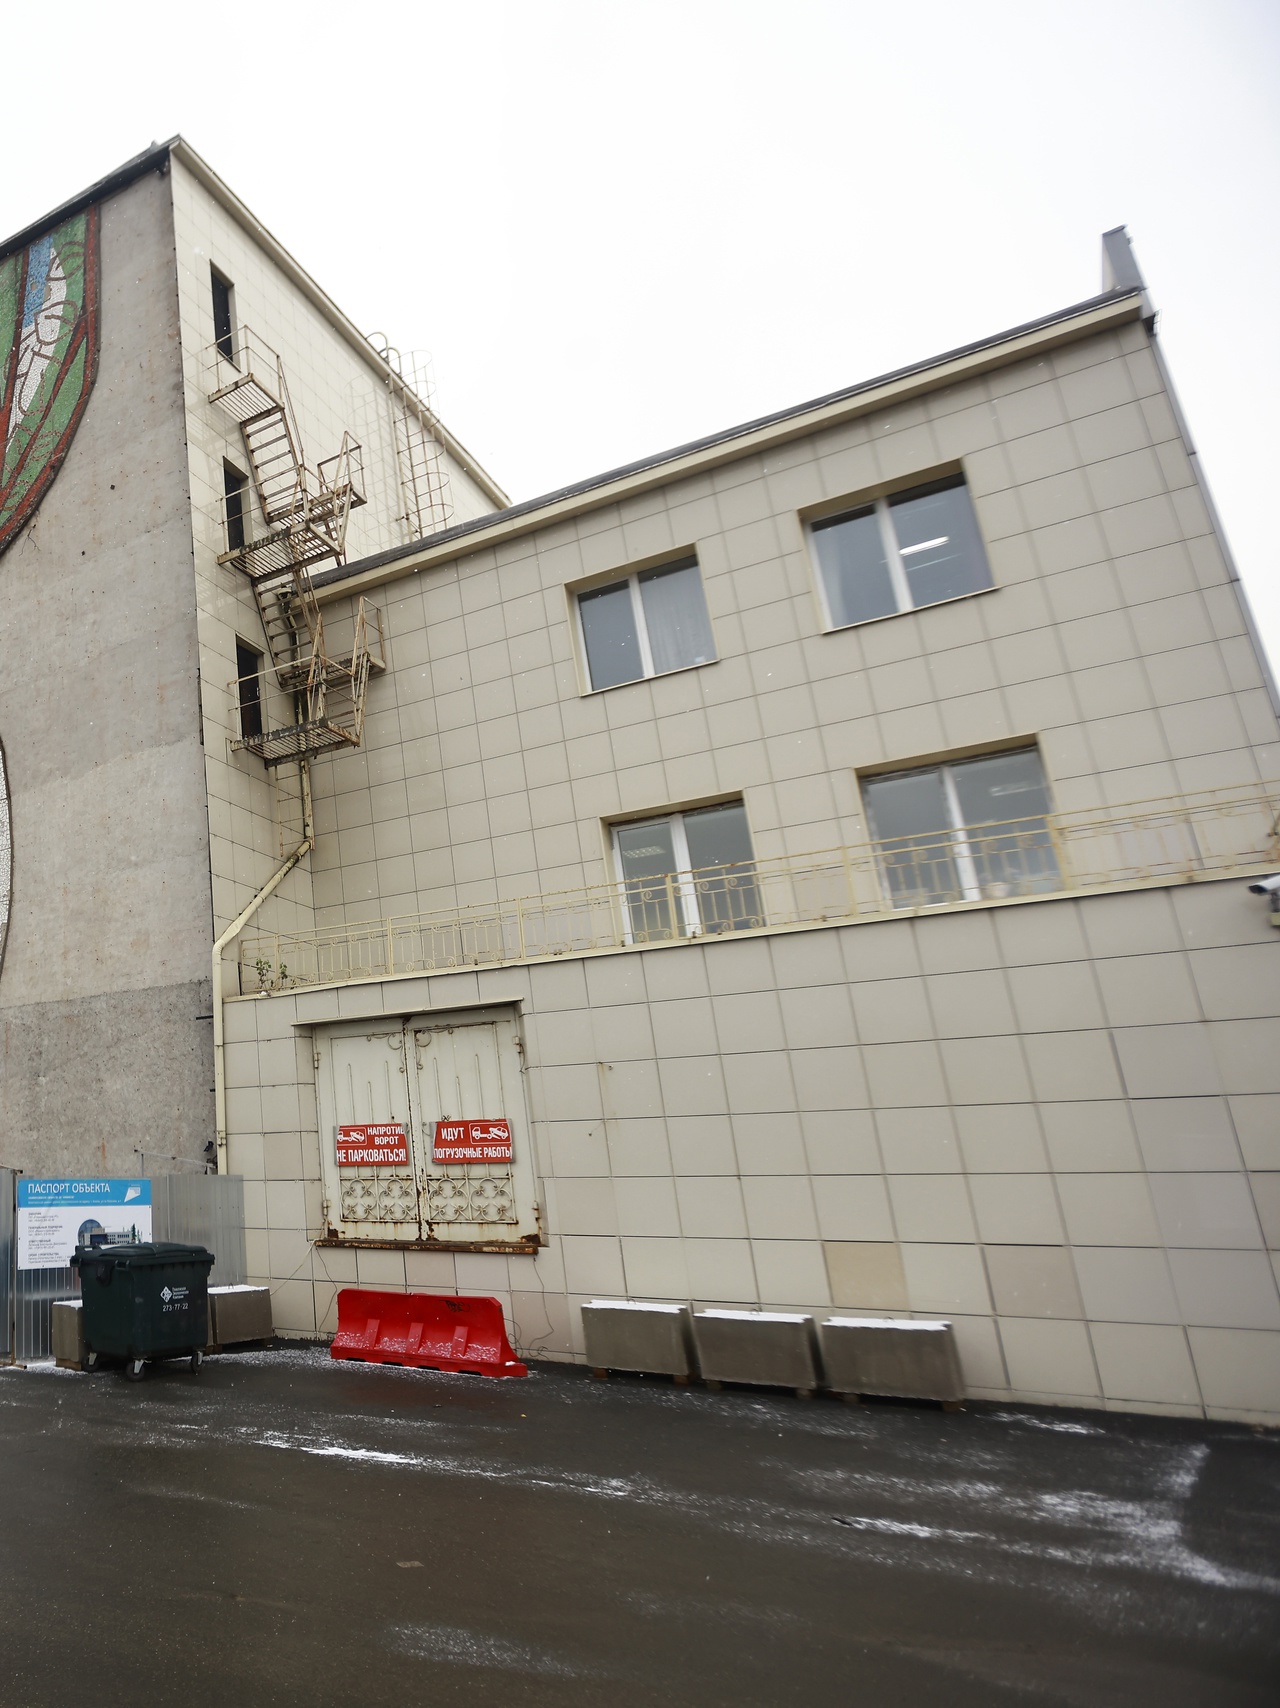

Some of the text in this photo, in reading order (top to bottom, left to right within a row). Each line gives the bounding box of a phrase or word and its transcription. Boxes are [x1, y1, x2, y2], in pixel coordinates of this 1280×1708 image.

[374, 1136, 399, 1145] ВОРОТ
[441, 1127, 464, 1141] ИДУТ
[336, 1148, 406, 1162] НЕ ПАРКОВАТЬСЯ!
[433, 1146, 512, 1159] ПОГРУЗОЧНЫЕ РАБОТЫ
[28, 1183, 110, 1193] ПАСПОРТ ОБЪЕКТА
